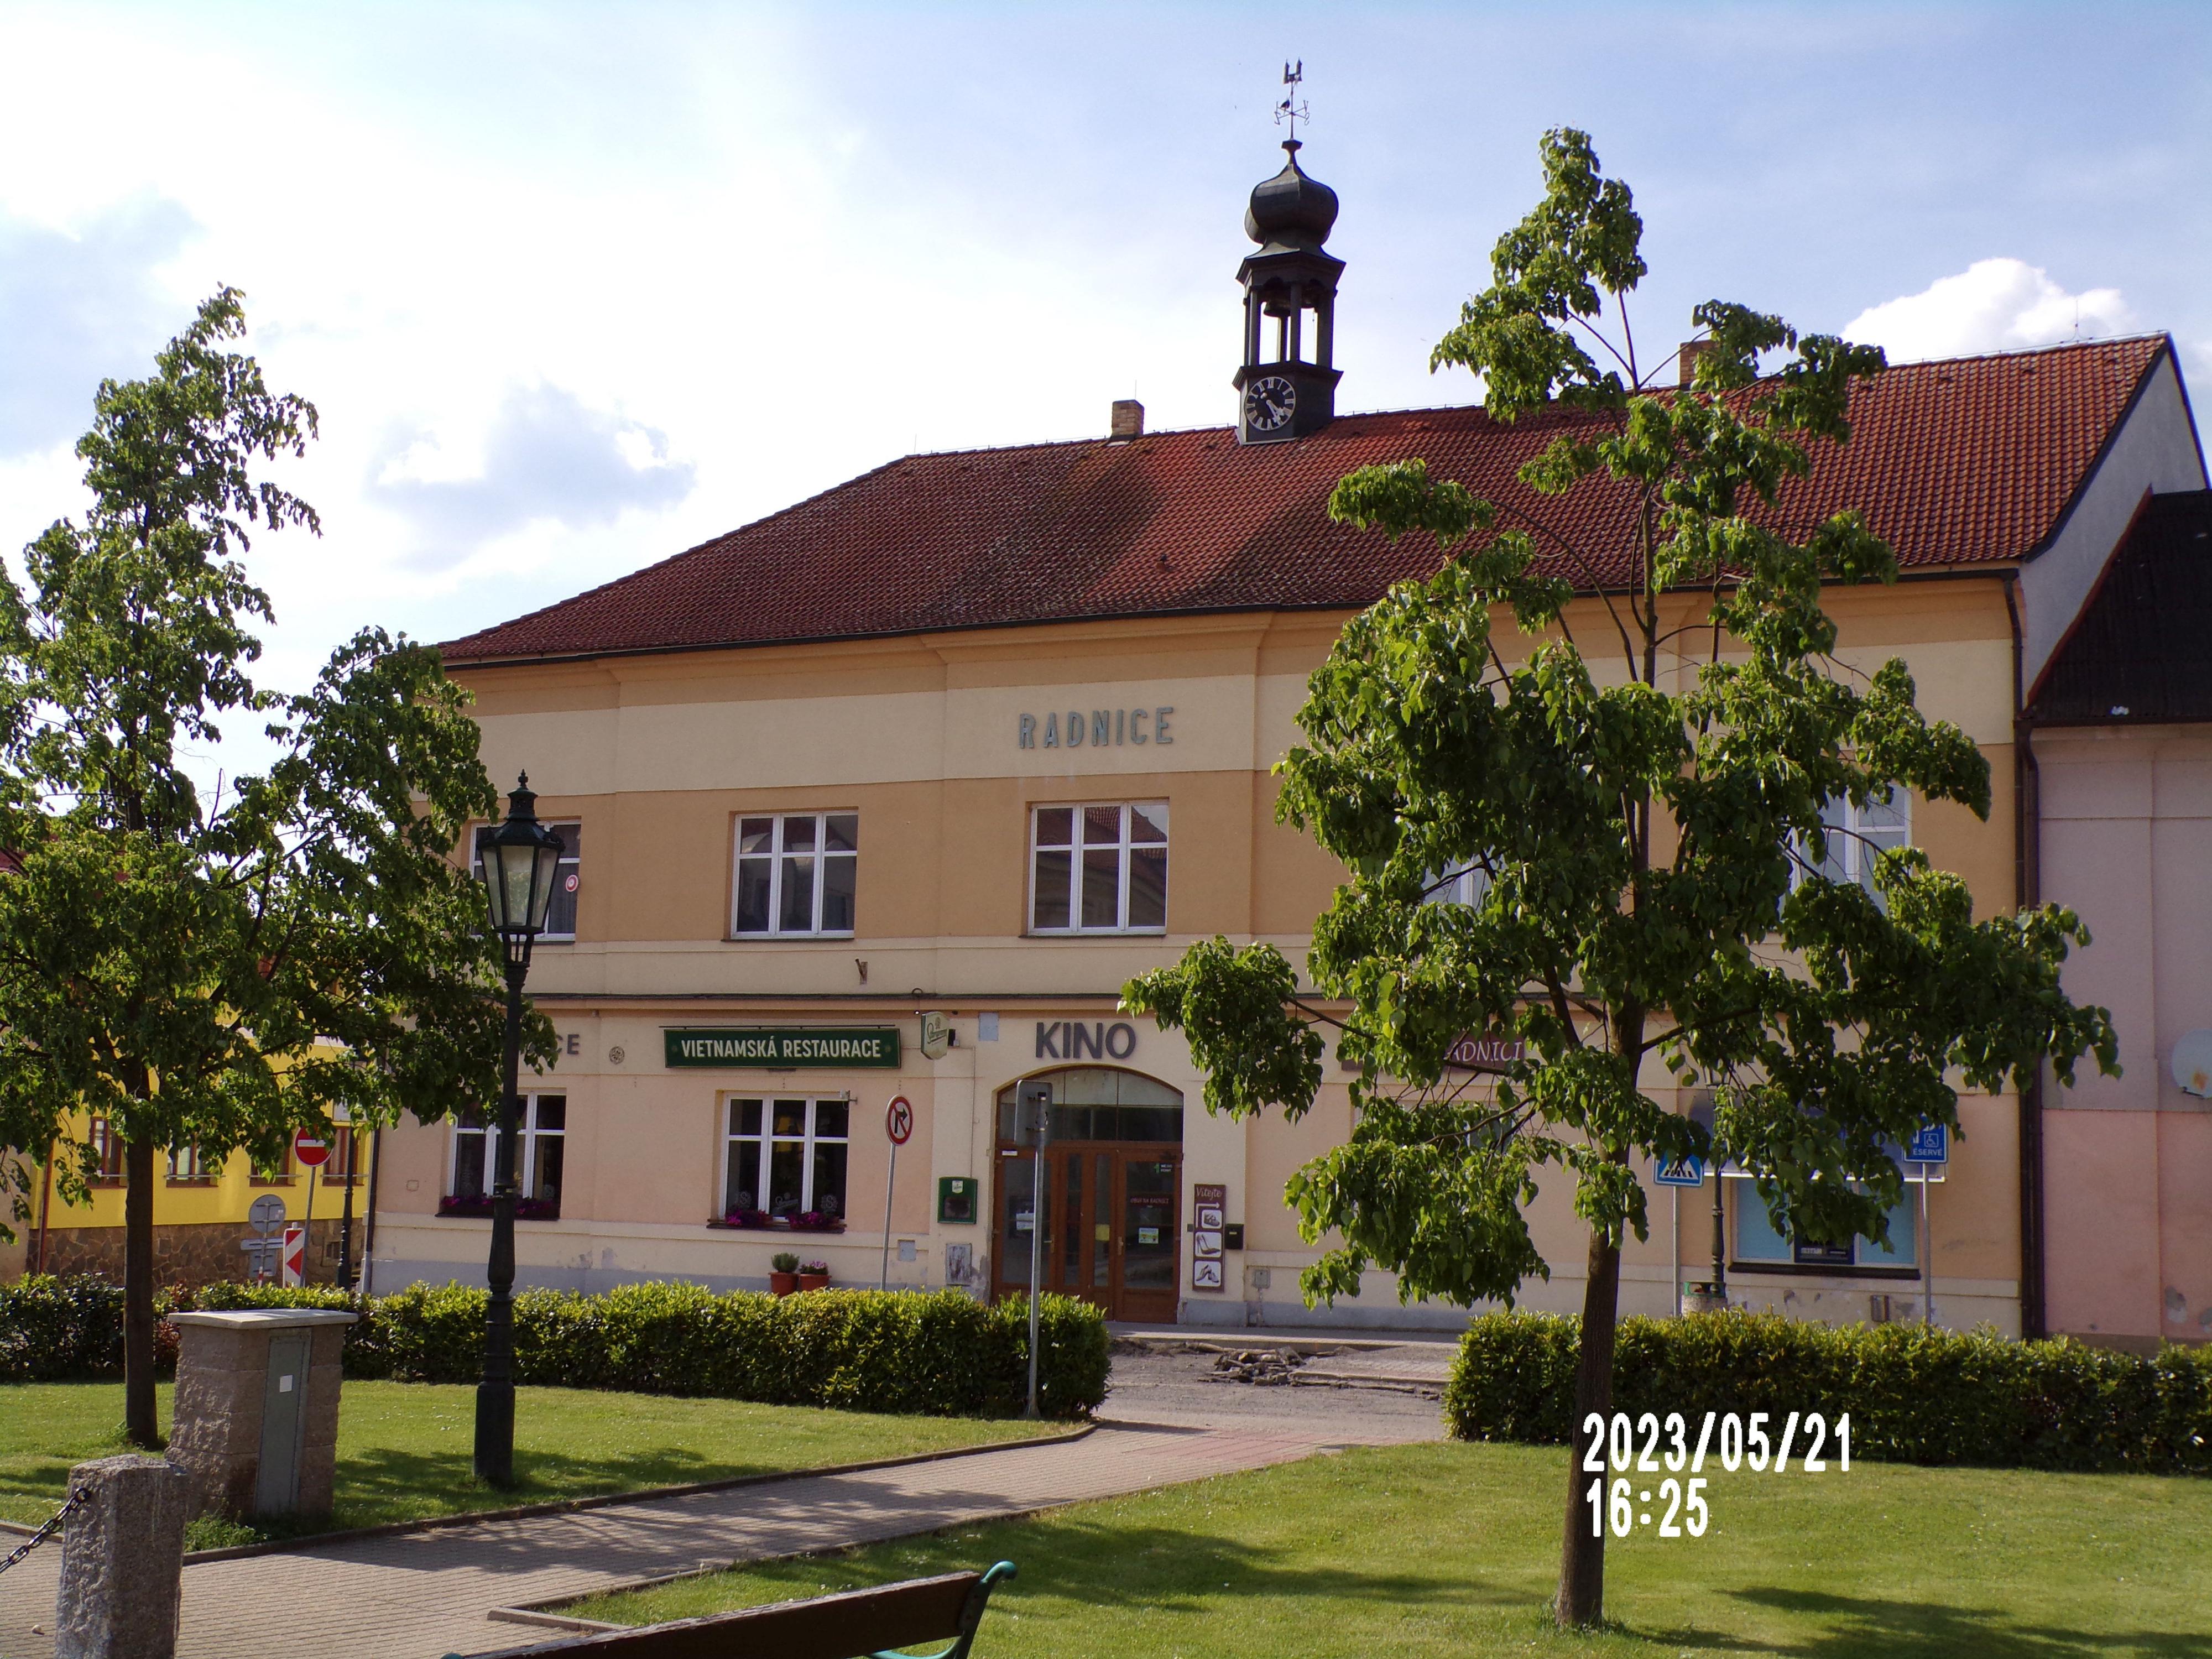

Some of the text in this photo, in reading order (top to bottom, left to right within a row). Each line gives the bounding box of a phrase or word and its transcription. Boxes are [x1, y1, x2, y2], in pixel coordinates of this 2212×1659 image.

[1019, 707, 1173, 749] RADNICE
[681, 1036, 881, 1058] VIETNAMSKÁ RESTAURACE
[1036, 1022, 1136, 1059] KINO
[1443, 1041, 1522, 1062] ADNICI
[1913, 1147, 1943, 1156] ÉSERVÉ
